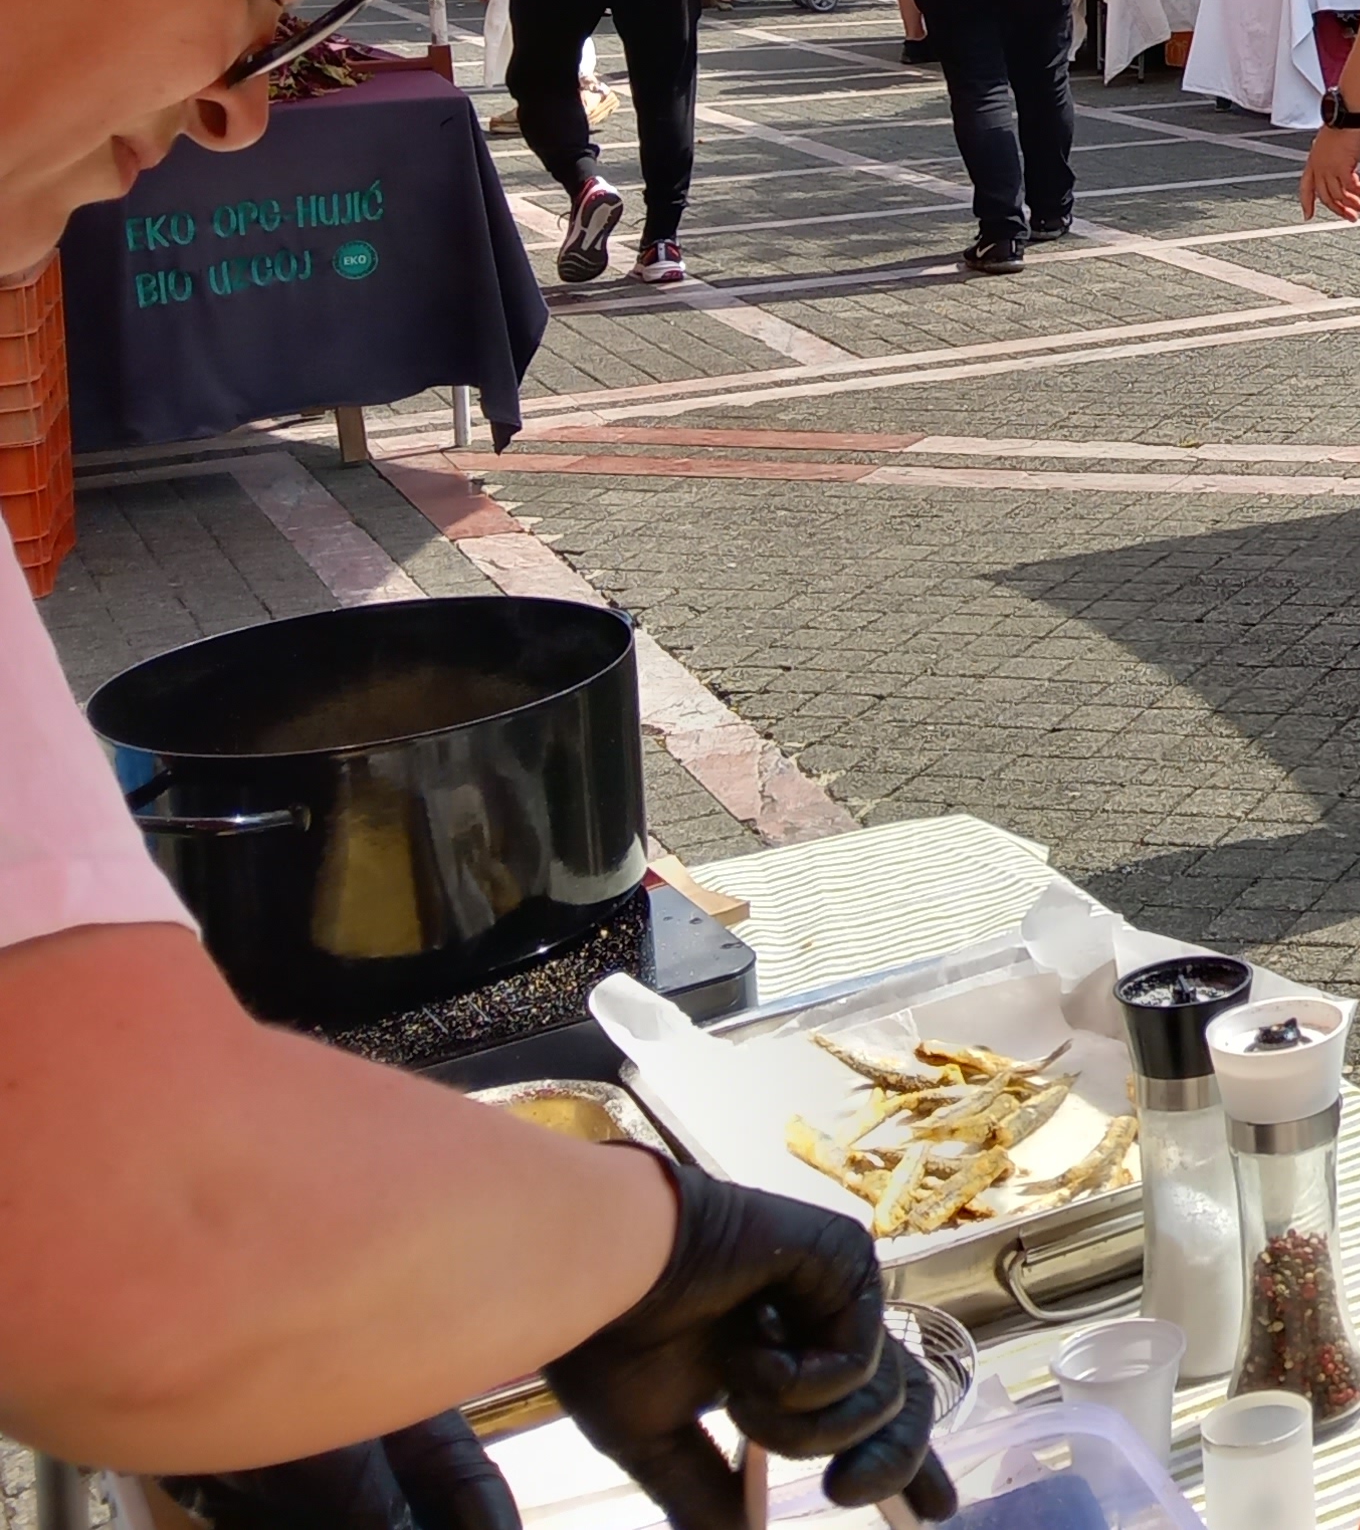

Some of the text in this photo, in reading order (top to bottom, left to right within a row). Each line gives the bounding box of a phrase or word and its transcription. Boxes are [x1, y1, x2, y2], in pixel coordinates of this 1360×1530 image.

[125, 213, 196, 253] EKO
[134, 248, 313, 309] BIO UZGOJ
[343, 254, 367, 266] EKO
